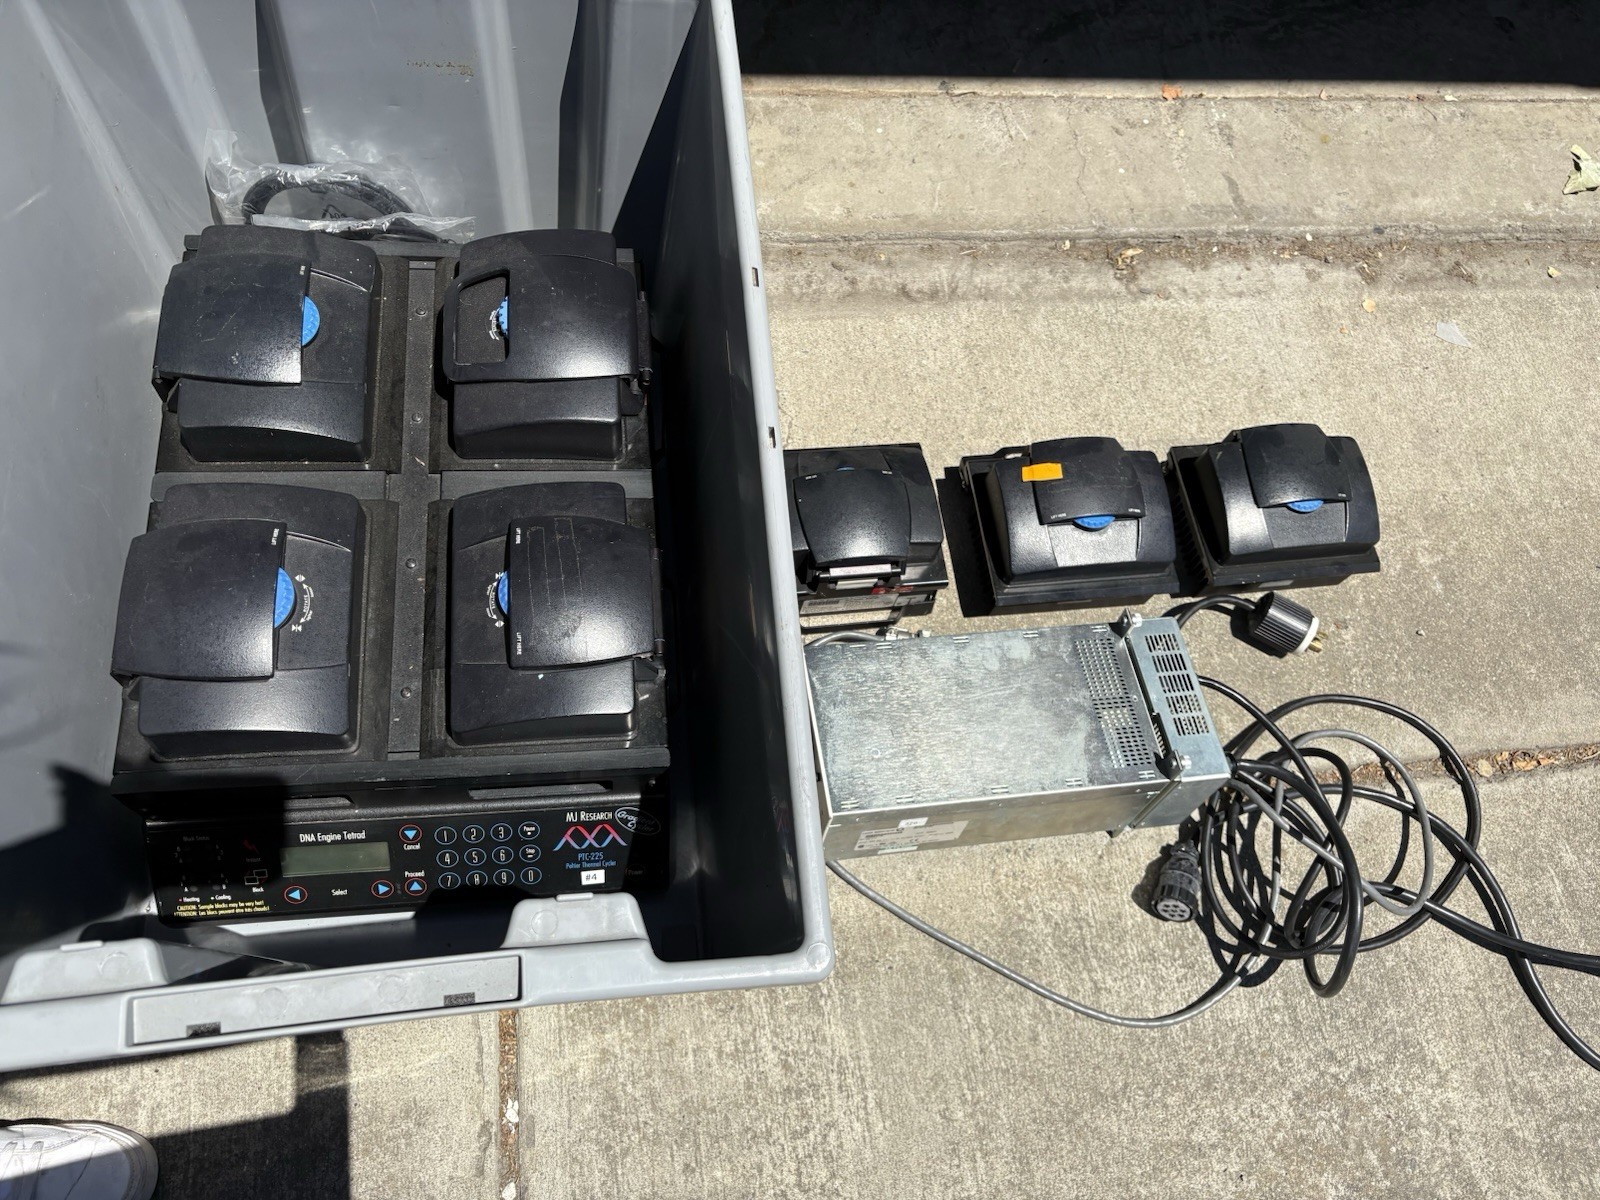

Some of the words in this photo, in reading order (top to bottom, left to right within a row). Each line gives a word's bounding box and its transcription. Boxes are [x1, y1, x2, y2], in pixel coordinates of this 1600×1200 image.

[565, 812, 578, 822] MJ
[580, 810, 613, 821] RESEARCH
[299, 832, 316, 843] DNA
[317, 832, 342, 842] Engine
[343, 830, 366, 840] Tetrad
[470, 828, 477, 840] 2
[499, 826, 505, 839] 3
[444, 853, 450, 865] 4
[472, 851, 478, 863] 5
[500, 849, 506, 862] 6
[578, 852, 604, 861] PTC-225
[602, 860, 617, 868] Cycler
[404, 870, 425, 878] Proceed
[473, 874, 480, 886] 8
[501, 872, 507, 884] 9
[528, 870, 534, 882] 0
[446, 876, 452, 887] 7
[331, 888, 348, 897] Select
